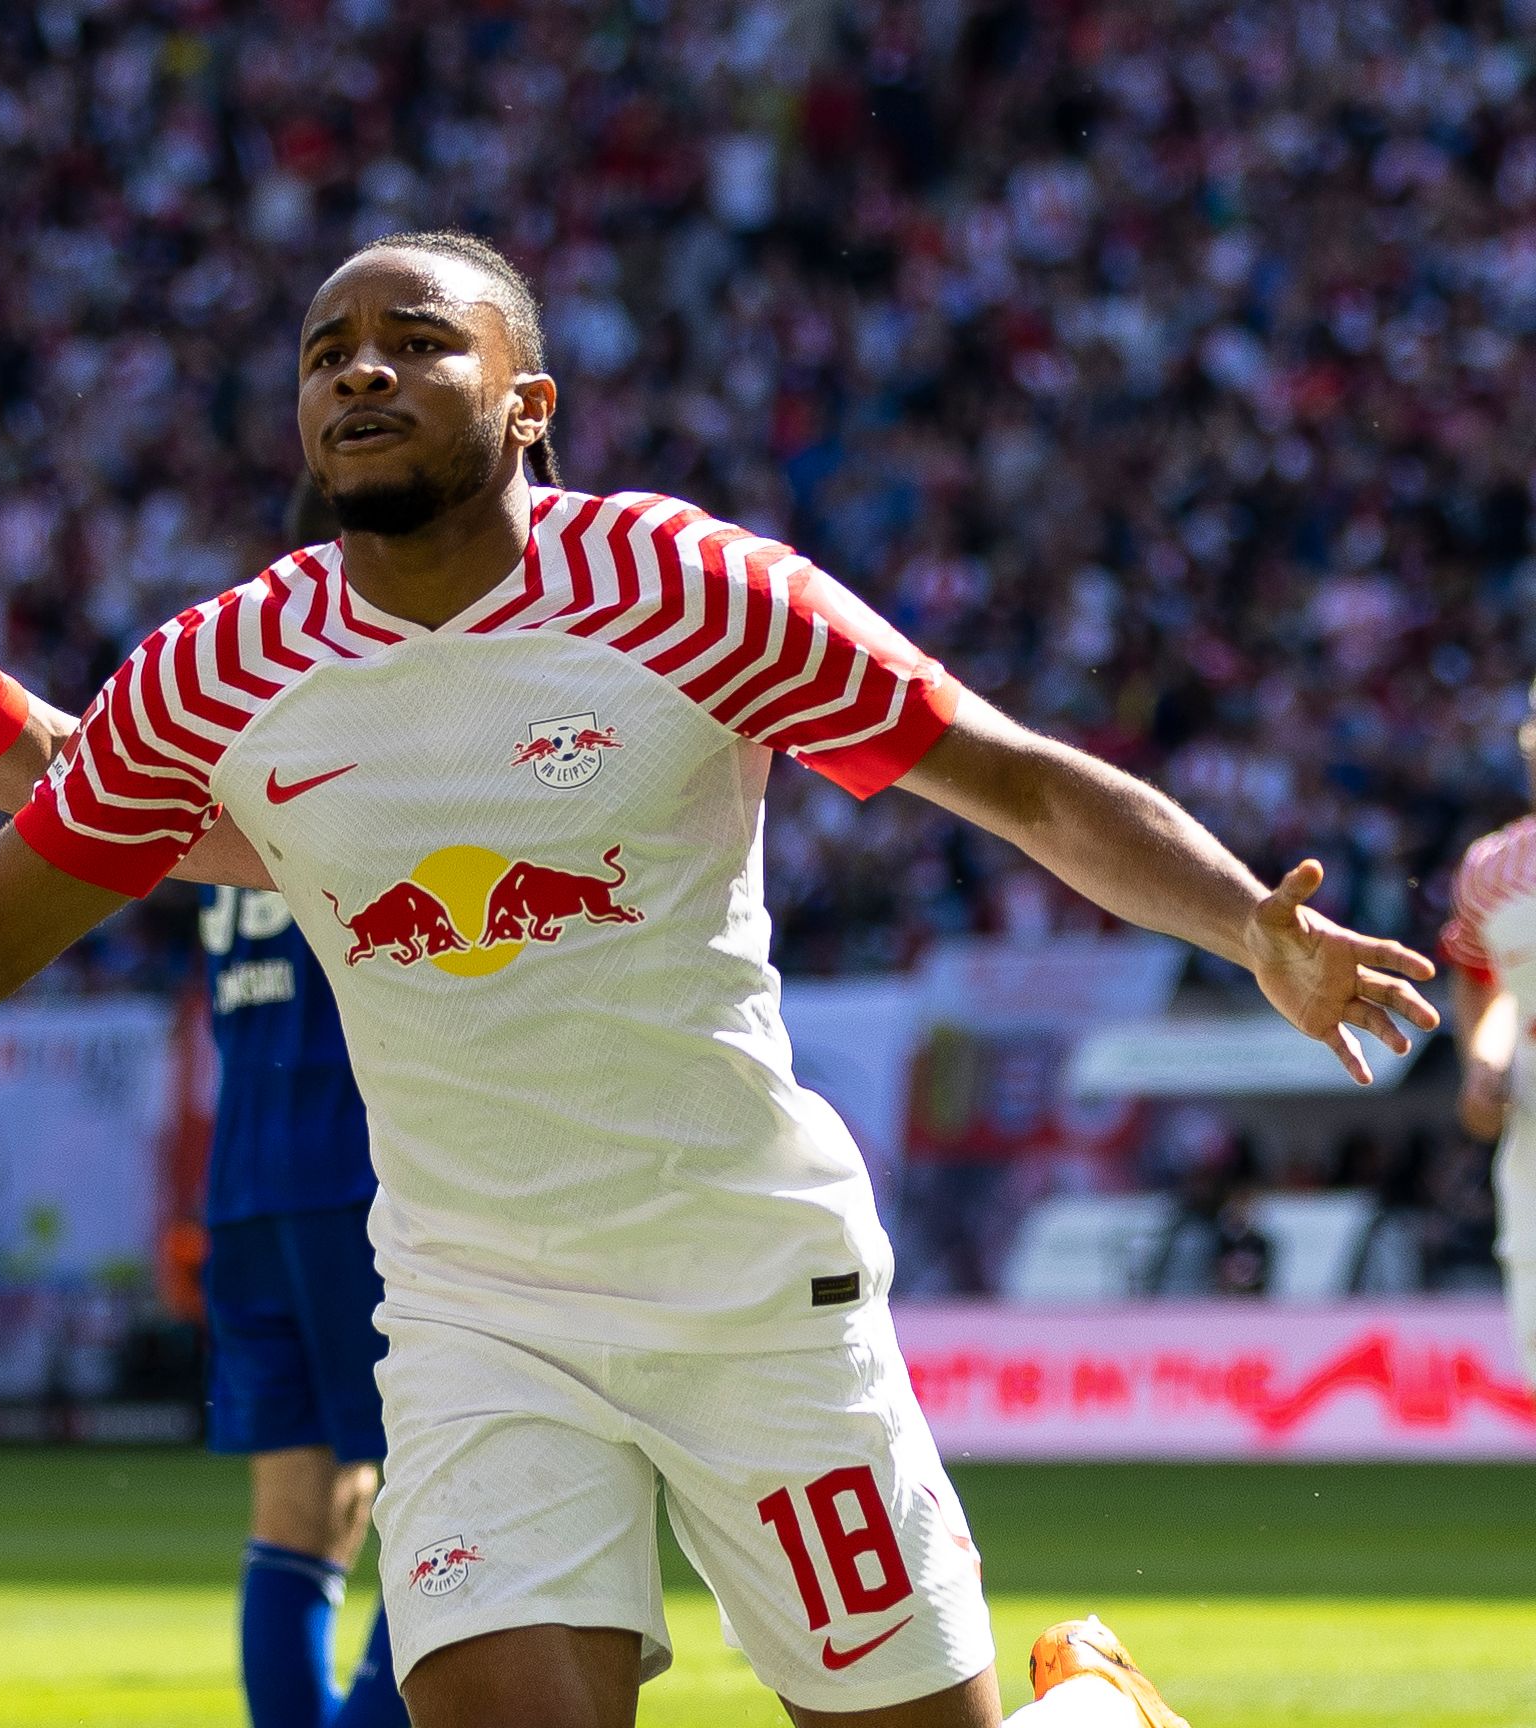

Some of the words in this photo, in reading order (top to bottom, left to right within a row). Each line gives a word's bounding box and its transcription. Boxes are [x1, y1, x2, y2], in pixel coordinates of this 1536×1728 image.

[540, 762, 556, 778] RB
[556, 755, 596, 782] LEIPZIG
[757, 1464, 914, 1632] 18
